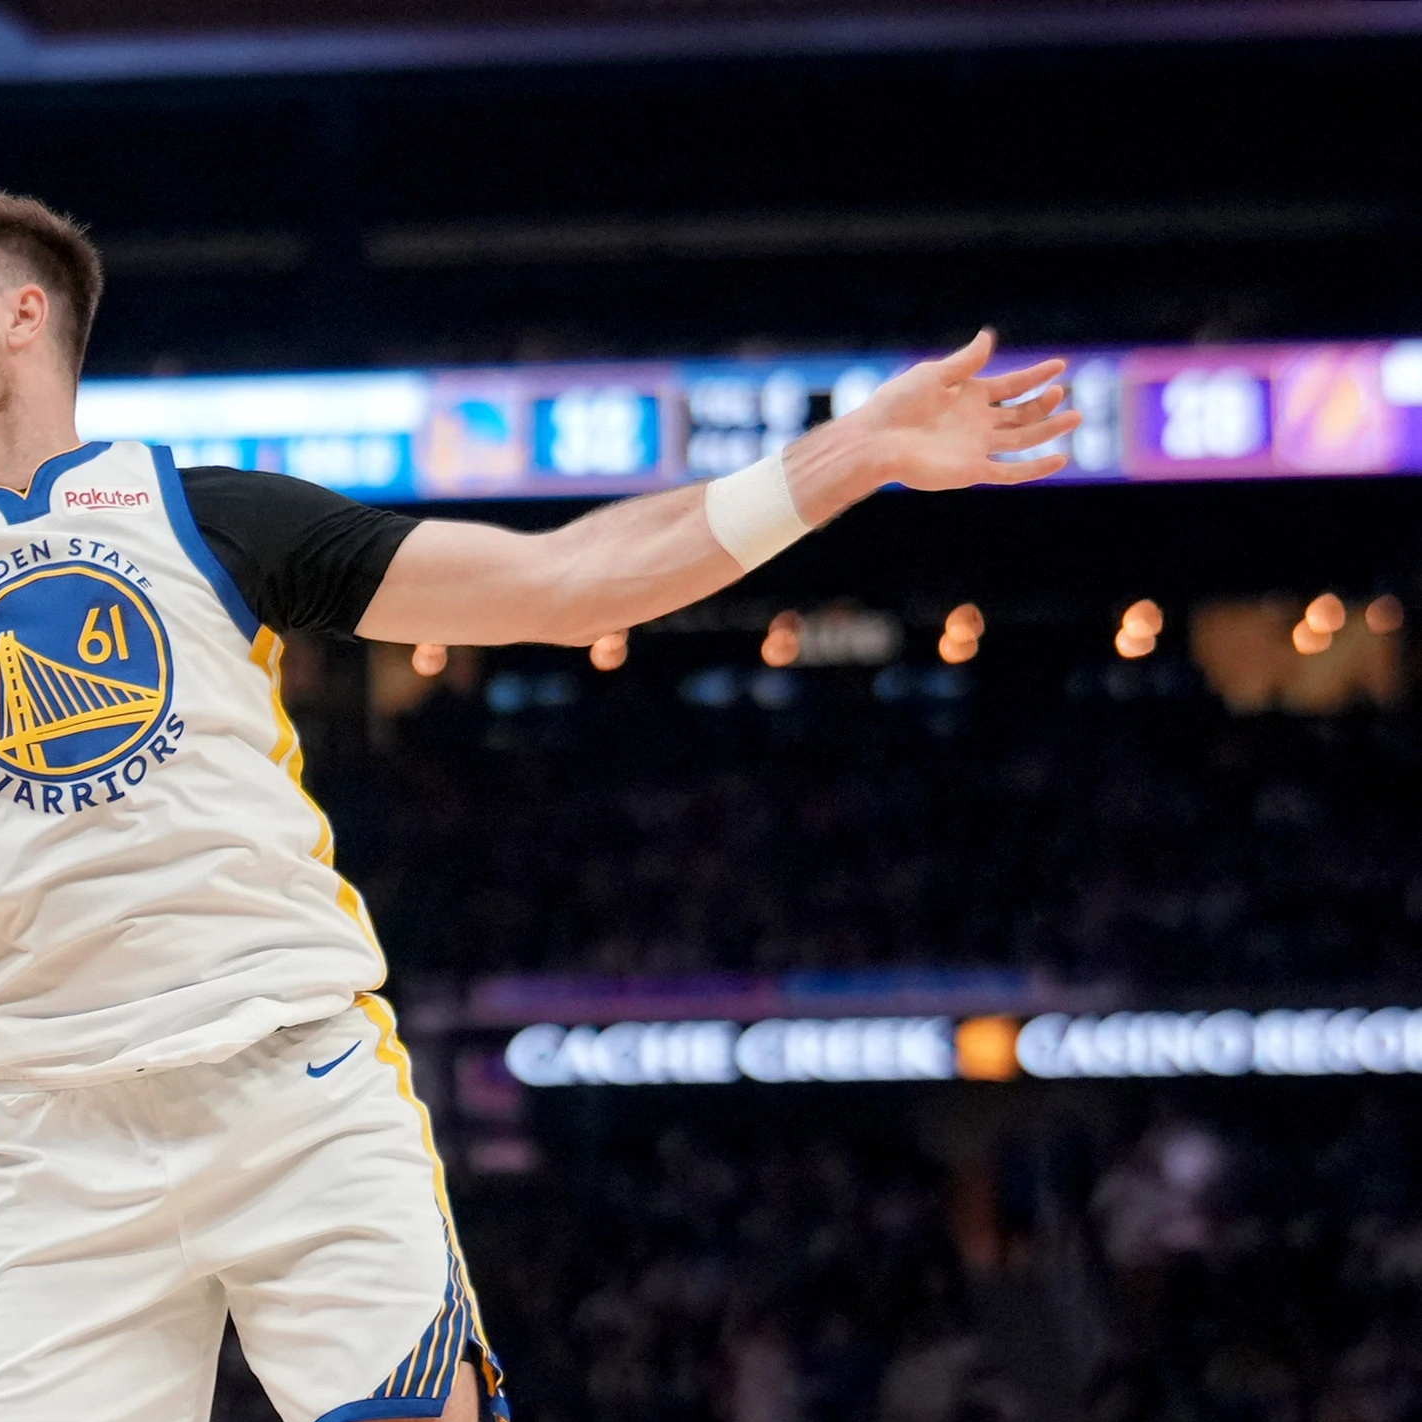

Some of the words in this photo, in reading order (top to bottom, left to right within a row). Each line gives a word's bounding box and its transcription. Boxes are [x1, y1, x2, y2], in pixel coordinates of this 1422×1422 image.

[64, 488, 150, 508] Rakuten
[68, 538, 153, 591] STATE
[77, 603, 130, 665] 61
